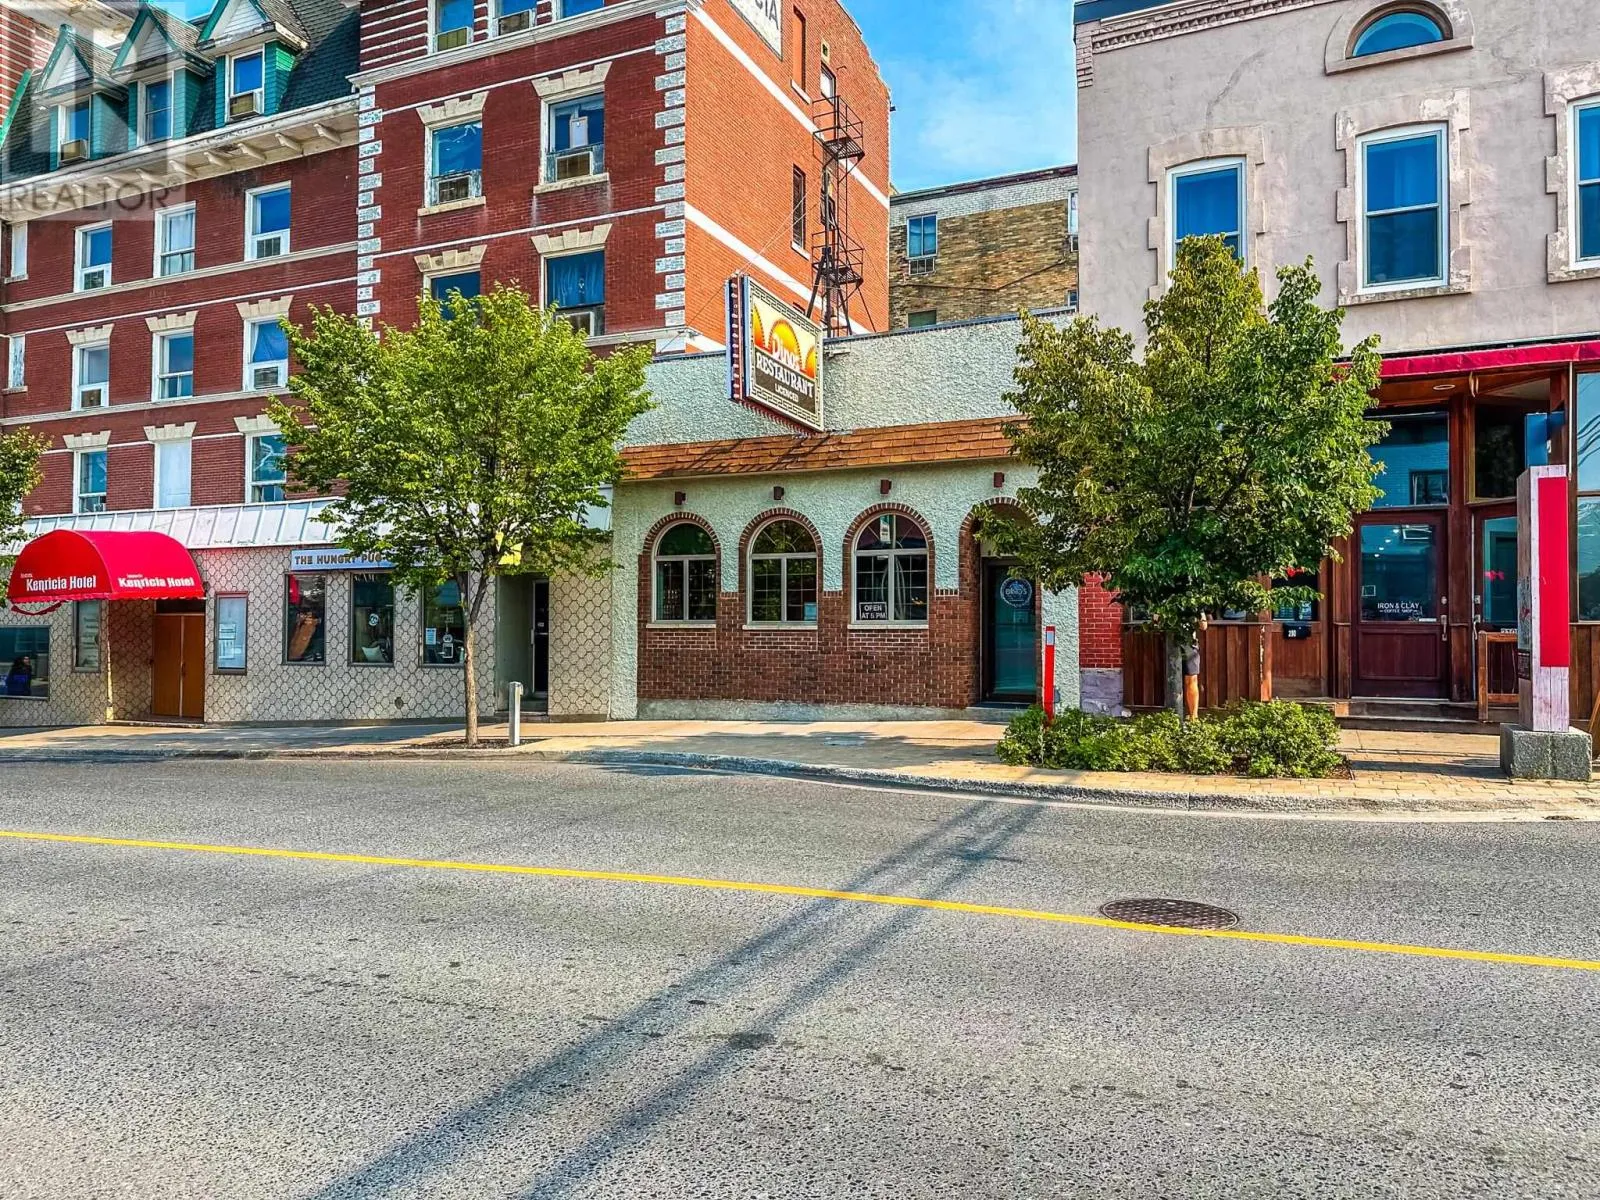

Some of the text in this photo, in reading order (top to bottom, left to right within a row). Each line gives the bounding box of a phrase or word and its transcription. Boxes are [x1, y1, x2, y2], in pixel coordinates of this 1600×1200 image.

[756, 351, 814, 398] RESTAURANT
[294, 555, 313, 565] THE
[26, 575, 97, 593] Kenricia Hotel
[118, 576, 195, 589] Kenricia Hotel
[864, 604, 882, 612] OPEN
